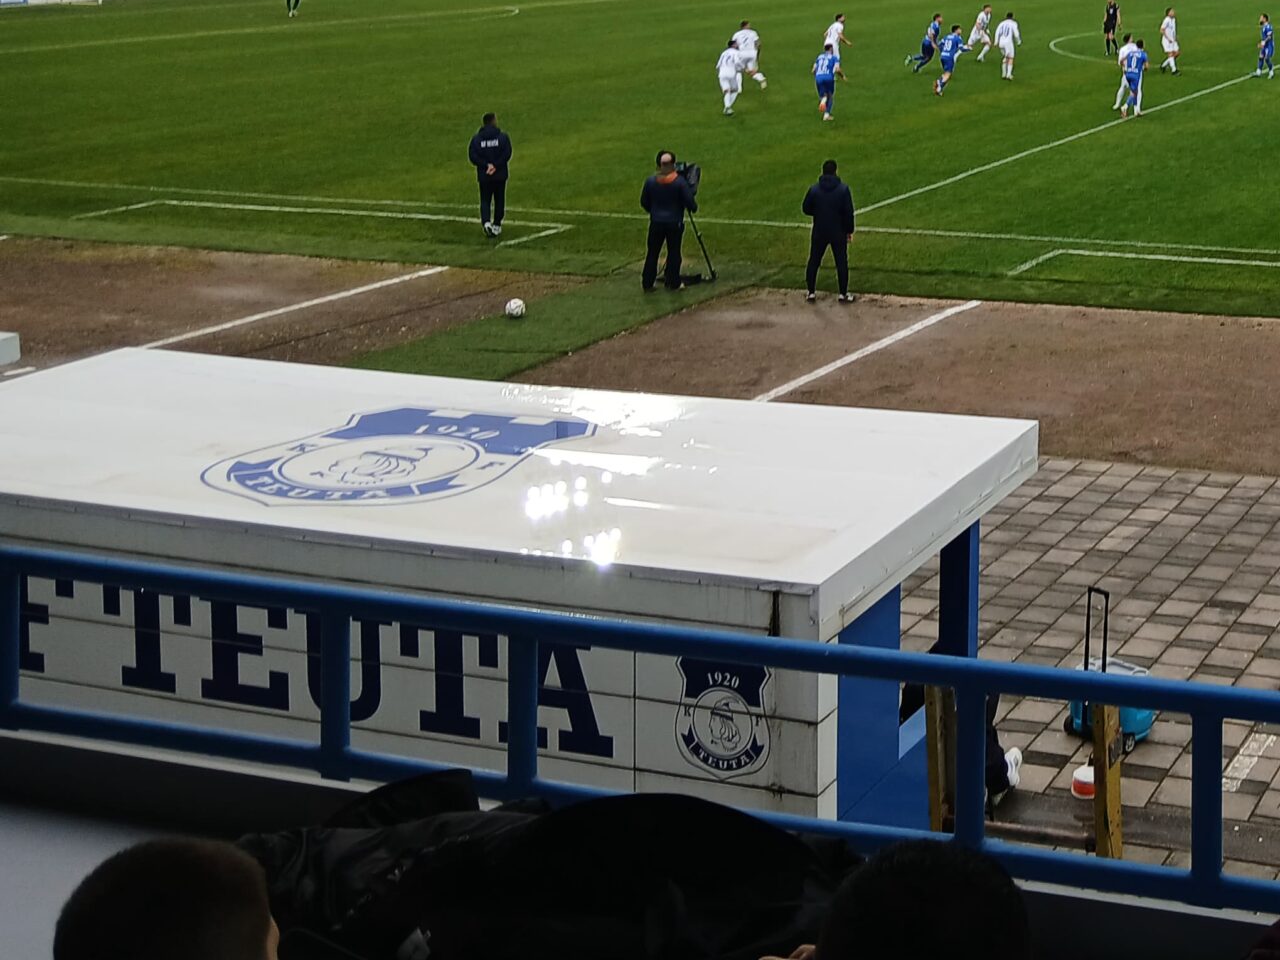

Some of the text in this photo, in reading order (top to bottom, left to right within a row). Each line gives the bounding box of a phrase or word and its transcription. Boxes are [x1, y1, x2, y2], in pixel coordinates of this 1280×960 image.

[416, 423, 501, 440] 1920
[244, 475, 391, 501] TEUTA
[101, 584, 614, 759] TEUTA
[706, 671, 741, 689] 1920
[698, 748, 751, 770] TEUTA
